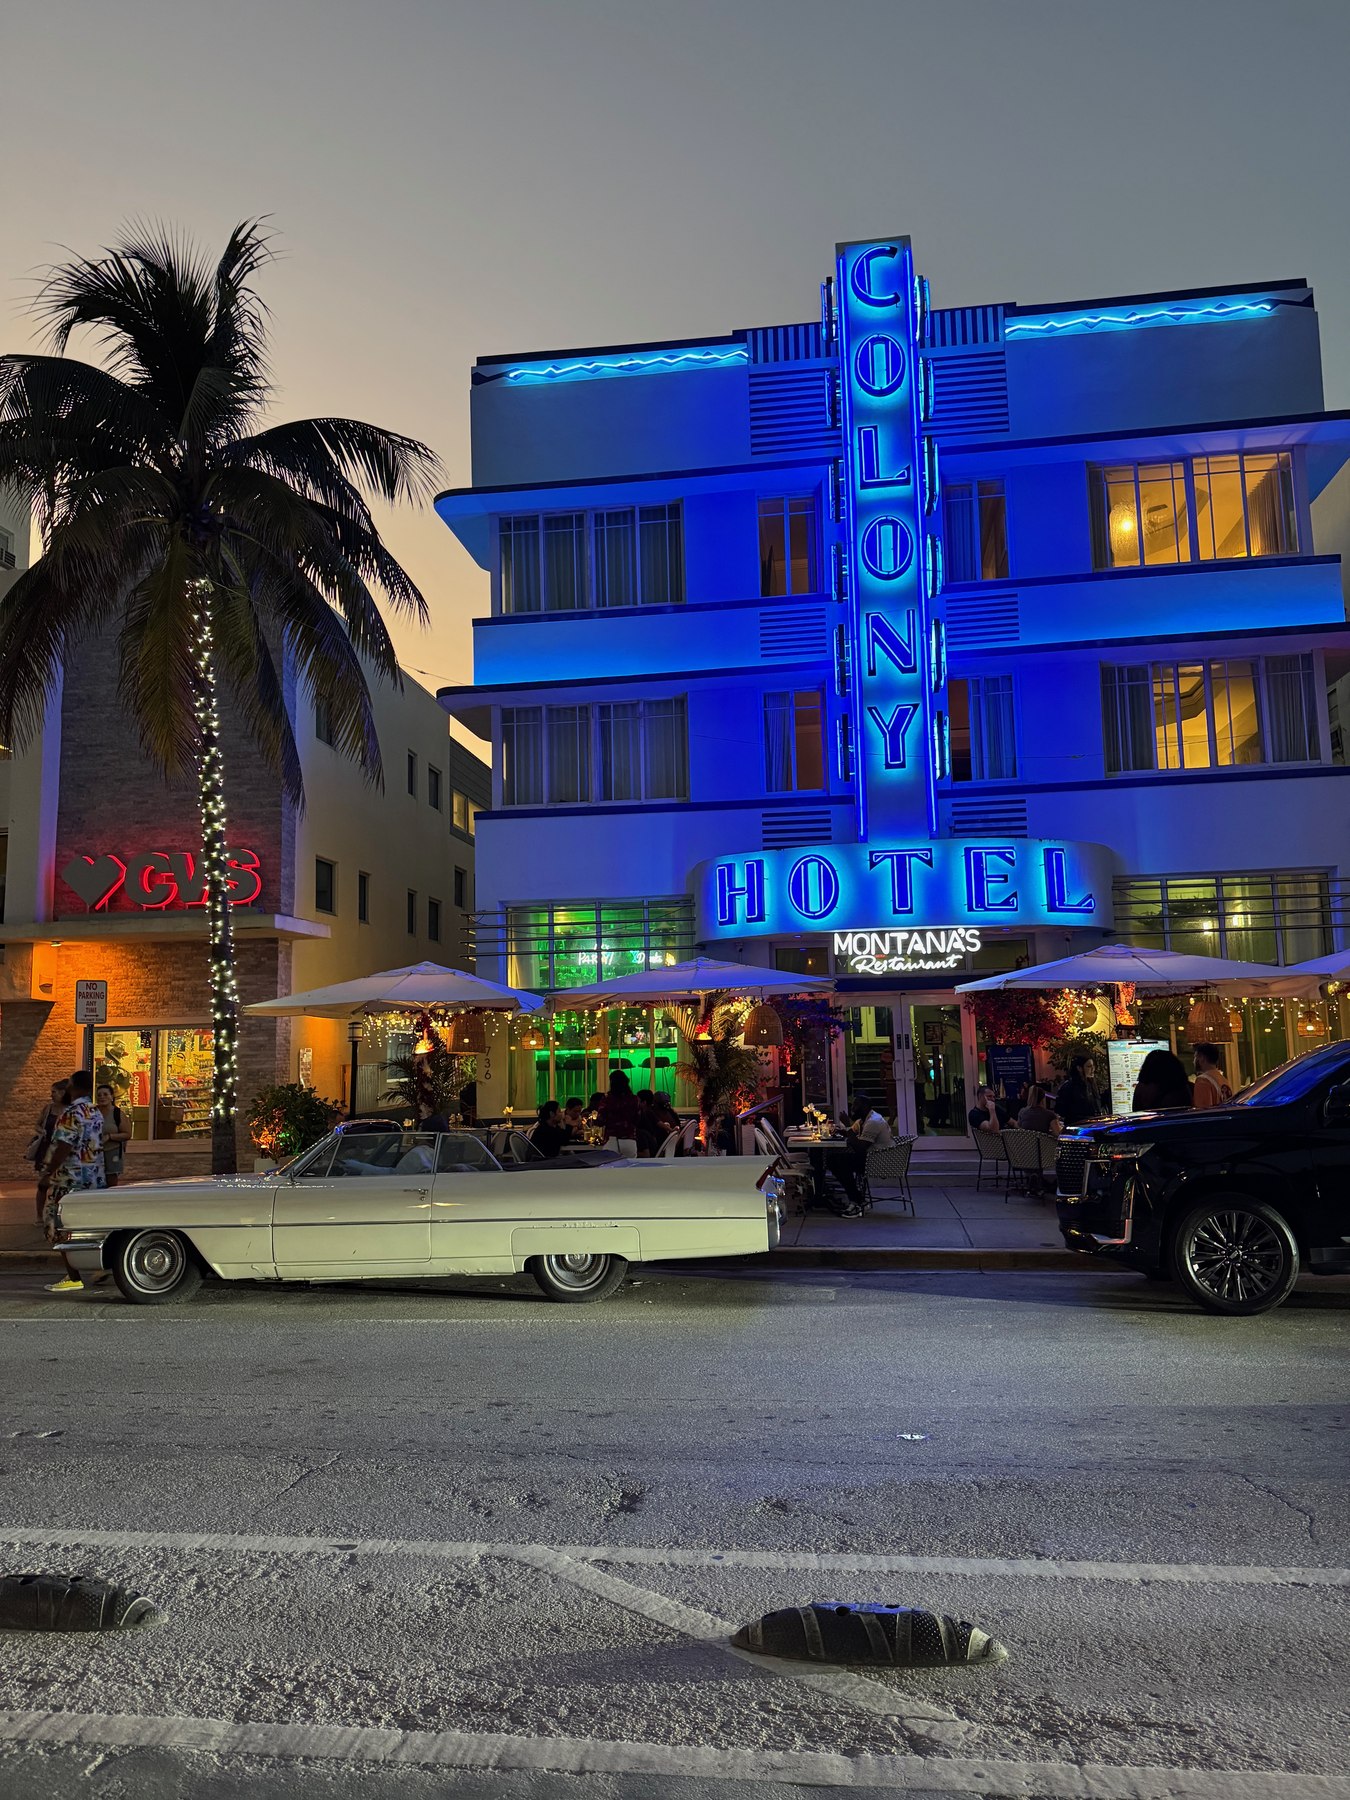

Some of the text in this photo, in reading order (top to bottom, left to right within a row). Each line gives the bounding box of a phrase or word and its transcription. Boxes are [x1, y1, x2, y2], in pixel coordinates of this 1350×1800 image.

[850, 246, 921, 770] COLONY
[124, 848, 262, 908] CVS
[716, 846, 1096, 926] HOTEL
[833, 927, 982, 956] MONTANA'S
[850, 953, 964, 975] Restaurant
[78, 991, 105, 1000] PARKING
[85, 982, 98, 991] NO
[484, 1046, 492, 1080] 736
